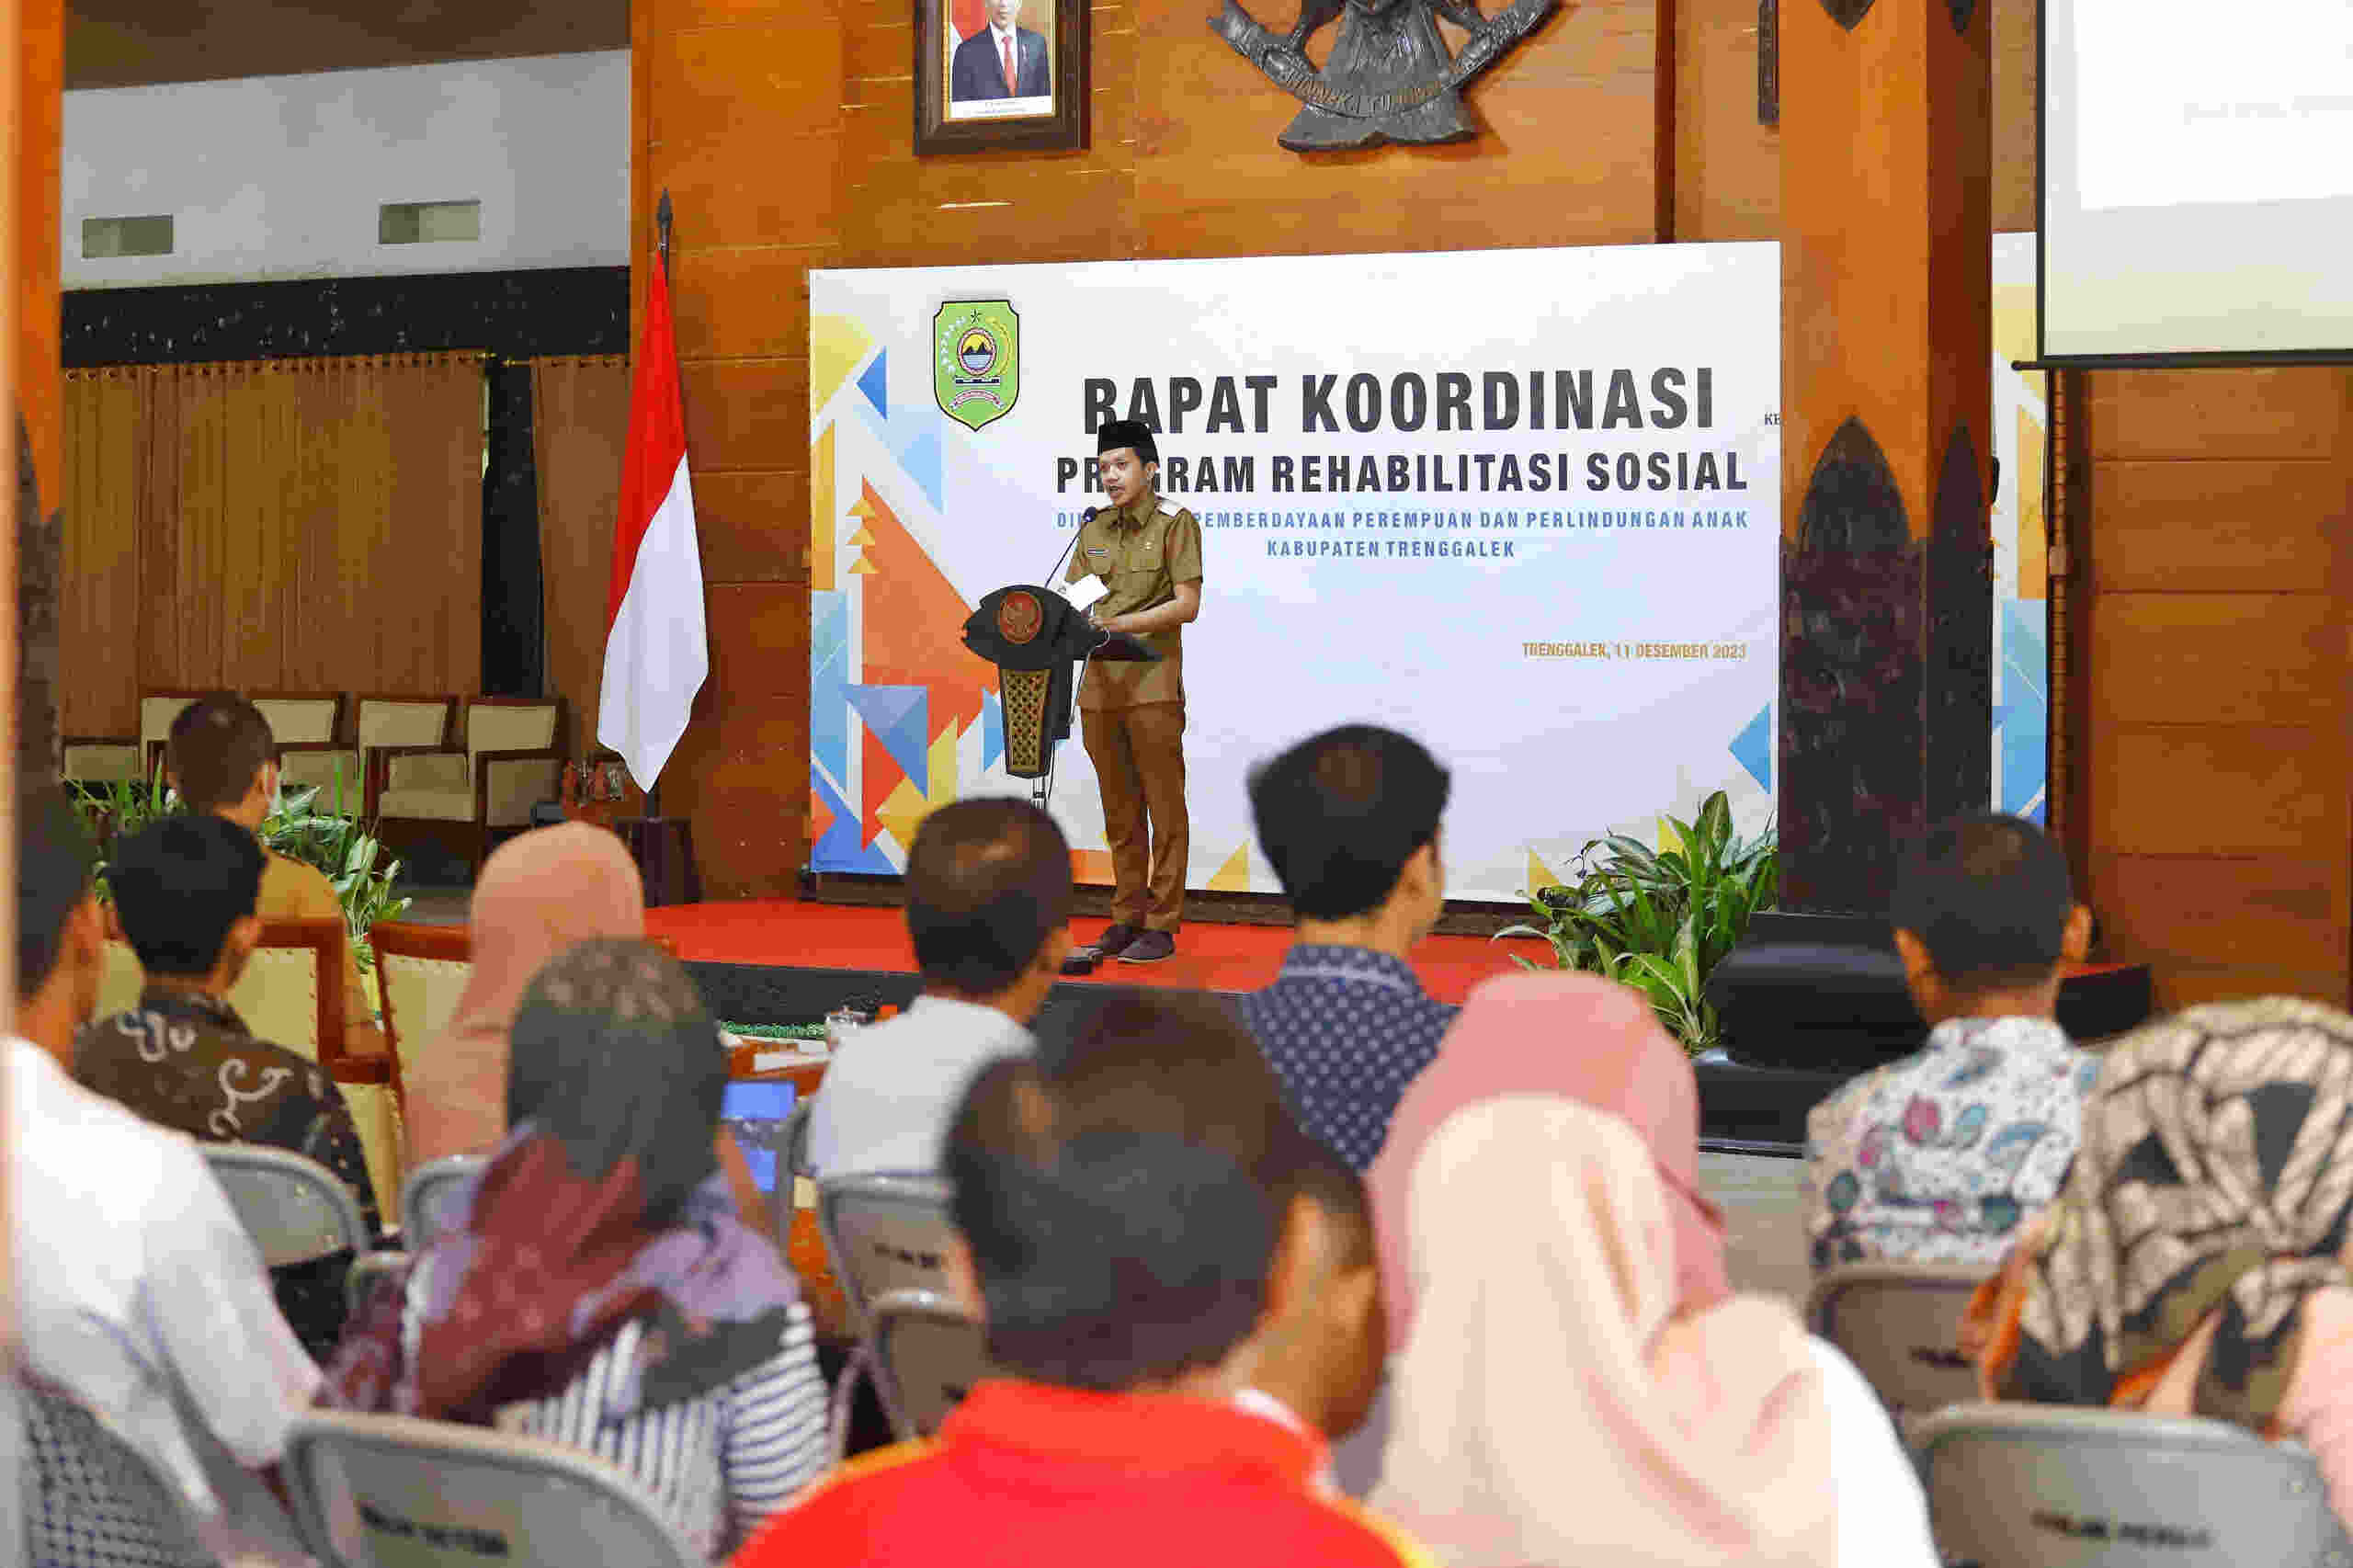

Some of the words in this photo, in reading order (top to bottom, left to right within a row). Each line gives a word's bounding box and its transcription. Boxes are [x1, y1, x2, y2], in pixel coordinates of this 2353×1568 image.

[1084, 374, 1278, 435] RAPAT
[1302, 367, 1712, 433] KOORDINASI
[1057, 455, 1255, 494] PRRAM
[1272, 453, 1568, 493] REHABILITASI
[1586, 451, 1747, 492] SOSIAL
[1352, 511, 1472, 528] PEREMPUAN
[1480, 511, 1518, 528] DAN
[1526, 511, 1685, 528] PERLINDUNGAN
[1692, 510, 1747, 528] ANAK
[1267, 540, 1380, 557] KABUPATEN
[1385, 540, 1515, 557] TRENGGALEK
